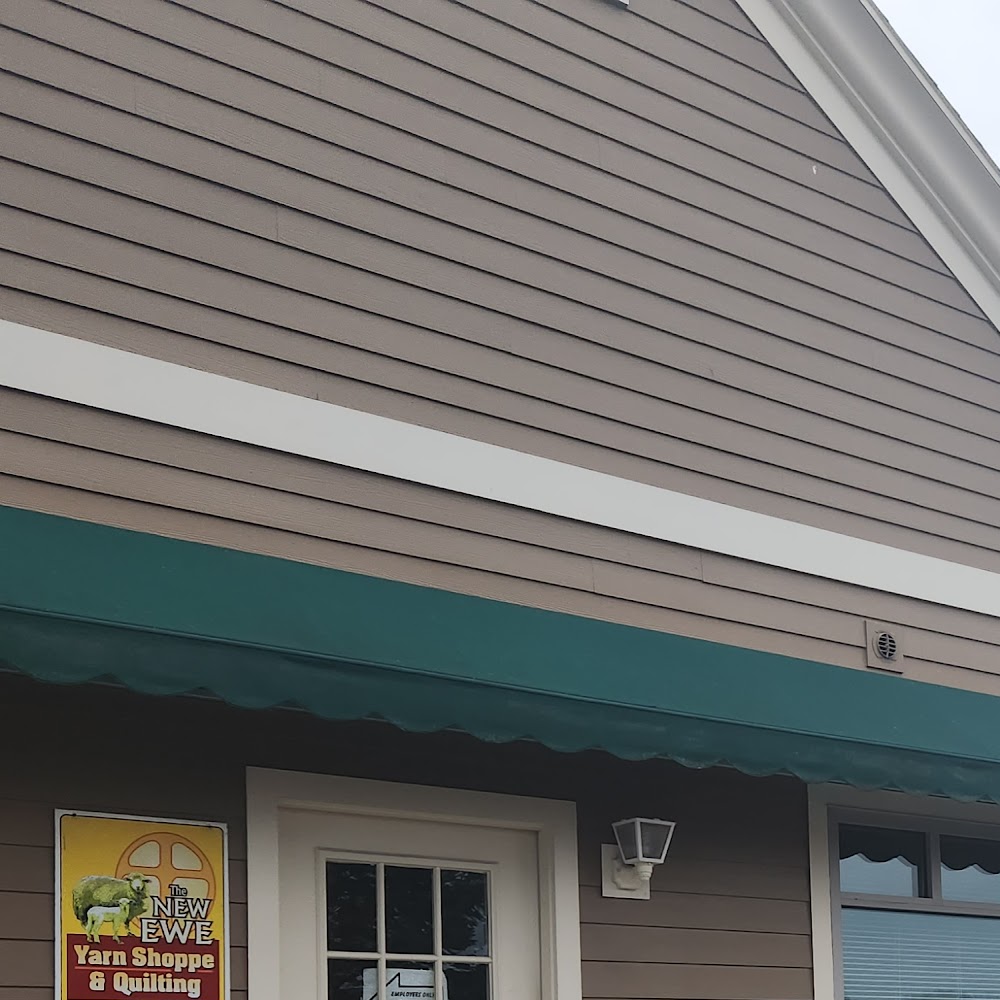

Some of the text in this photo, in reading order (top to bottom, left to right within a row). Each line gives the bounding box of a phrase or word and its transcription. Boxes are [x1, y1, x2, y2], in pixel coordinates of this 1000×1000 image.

[169, 884, 187, 897] The
[151, 896, 210, 919] NEW
[140, 918, 215, 945] EWE
[74, 944, 215, 973] Yarn Shoppe
[89, 971, 201, 998] & Quilting
